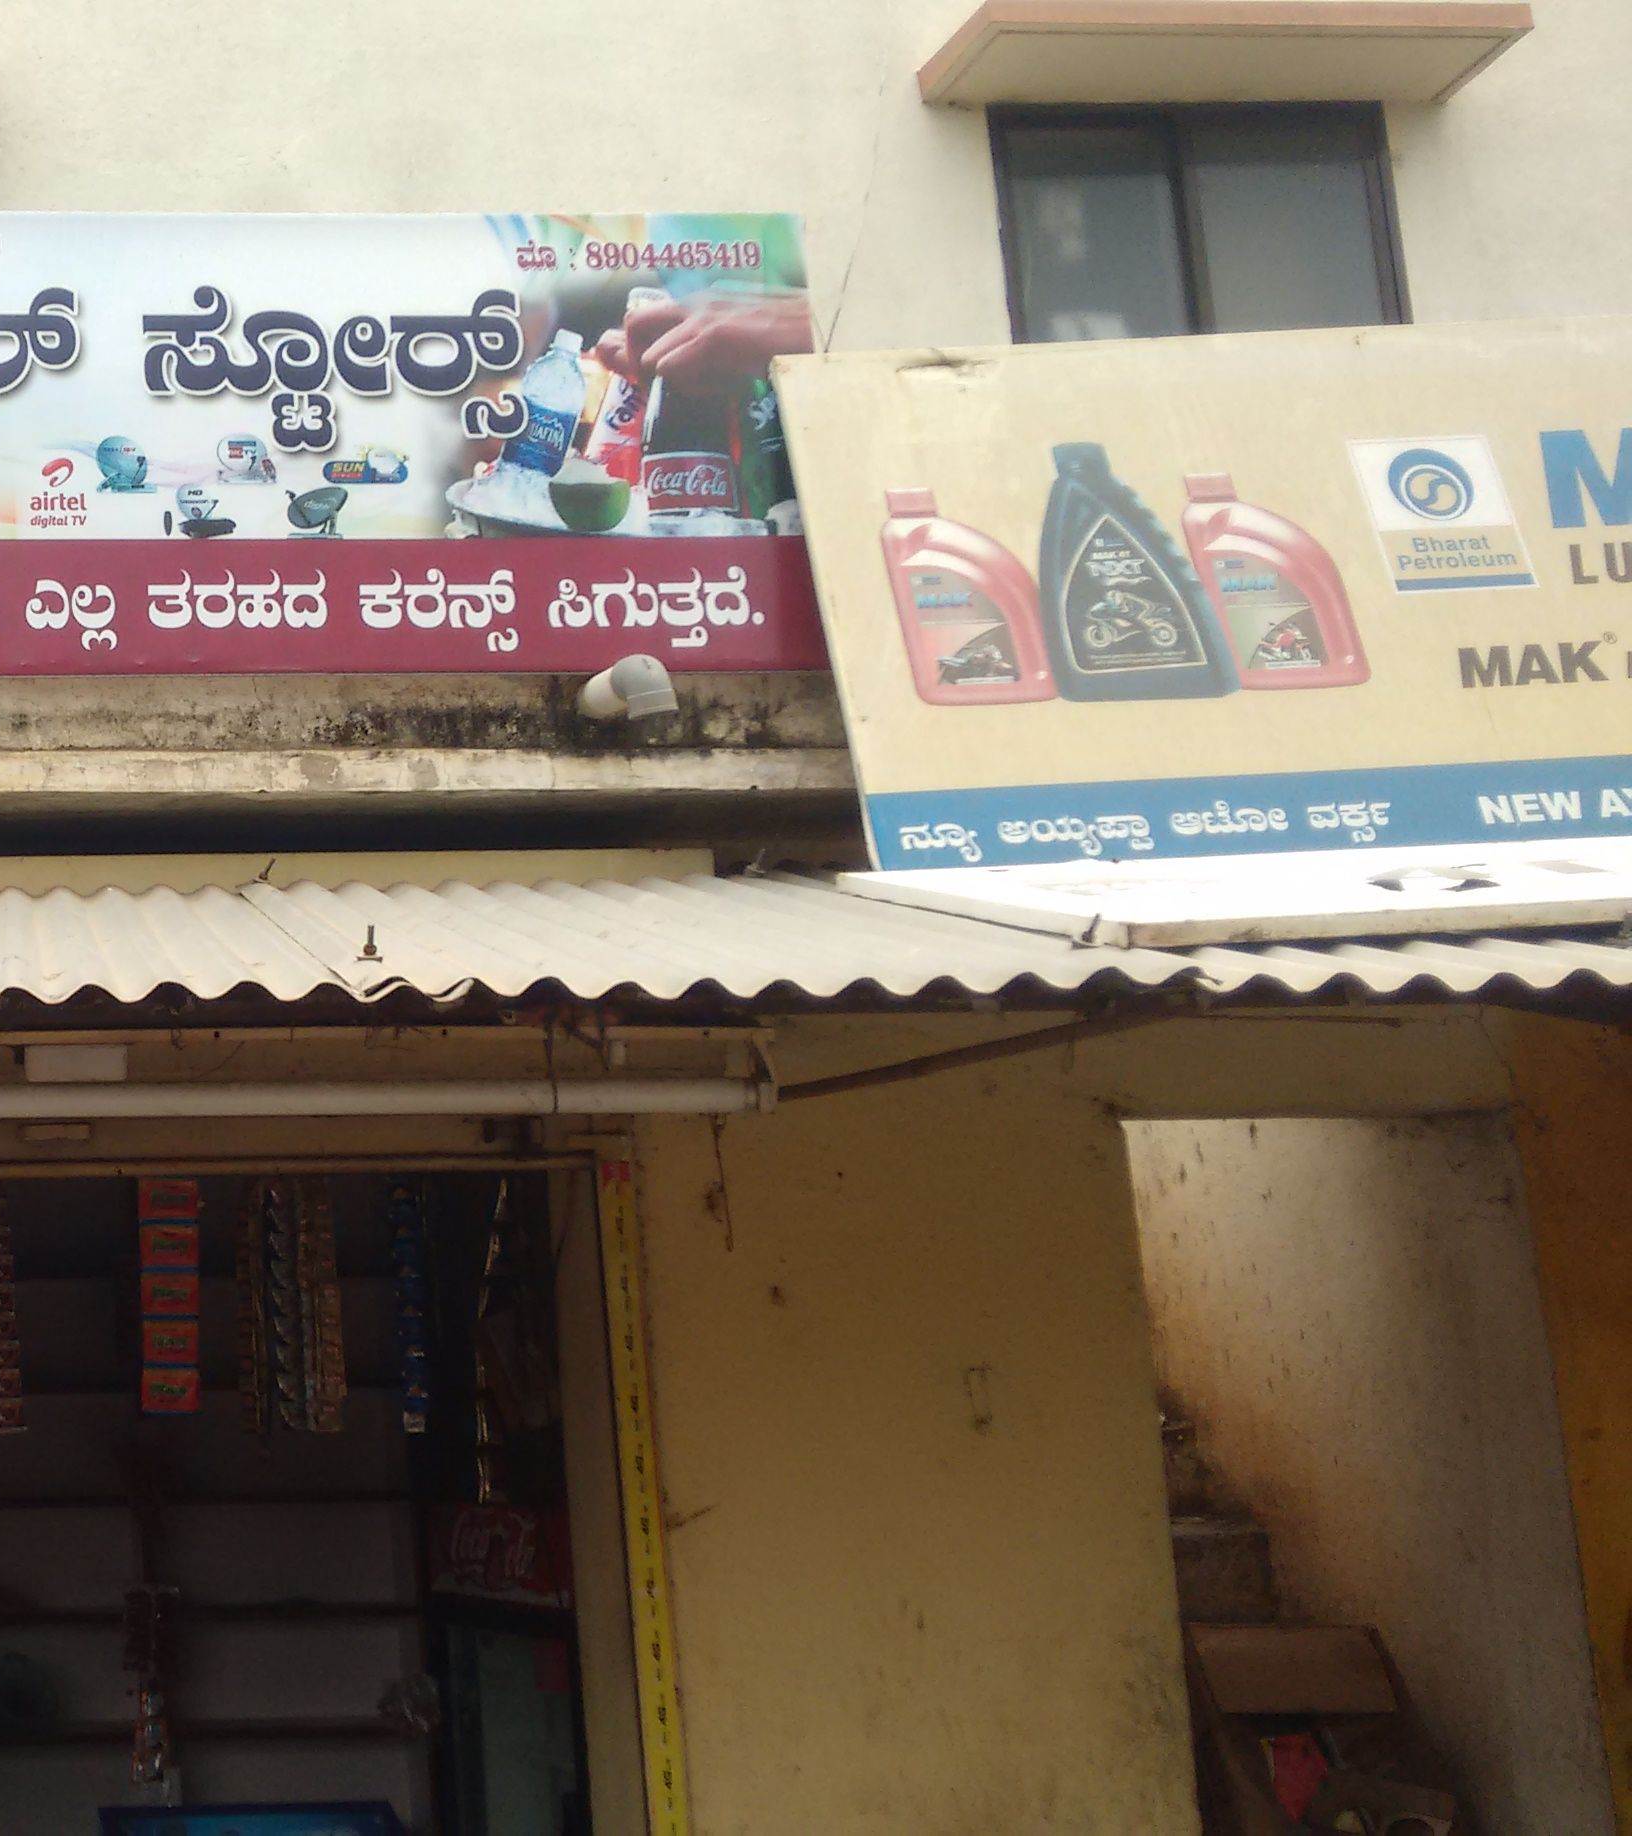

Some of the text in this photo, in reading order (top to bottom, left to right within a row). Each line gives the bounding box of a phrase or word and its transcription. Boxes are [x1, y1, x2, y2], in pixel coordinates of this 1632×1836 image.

[585, 240, 763, 271] 8904465419
[29, 491, 88, 513] airtel
[30, 514, 88, 530] digital TV
[1411, 534, 1491, 554] Bharat
[1398, 551, 1518, 571] Petroleum
[25, 578, 118, 651] ಎಲ್ಲ
[147, 569, 328, 629] ತರಹದ
[548, 565, 766, 648] ಸಿಗುತ್ತದೆ.
[1477, 790, 1583, 826] NEW
[899, 820, 982, 863] ನ್ಯೂ
[1170, 799, 1289, 836] ಆಟೋ
